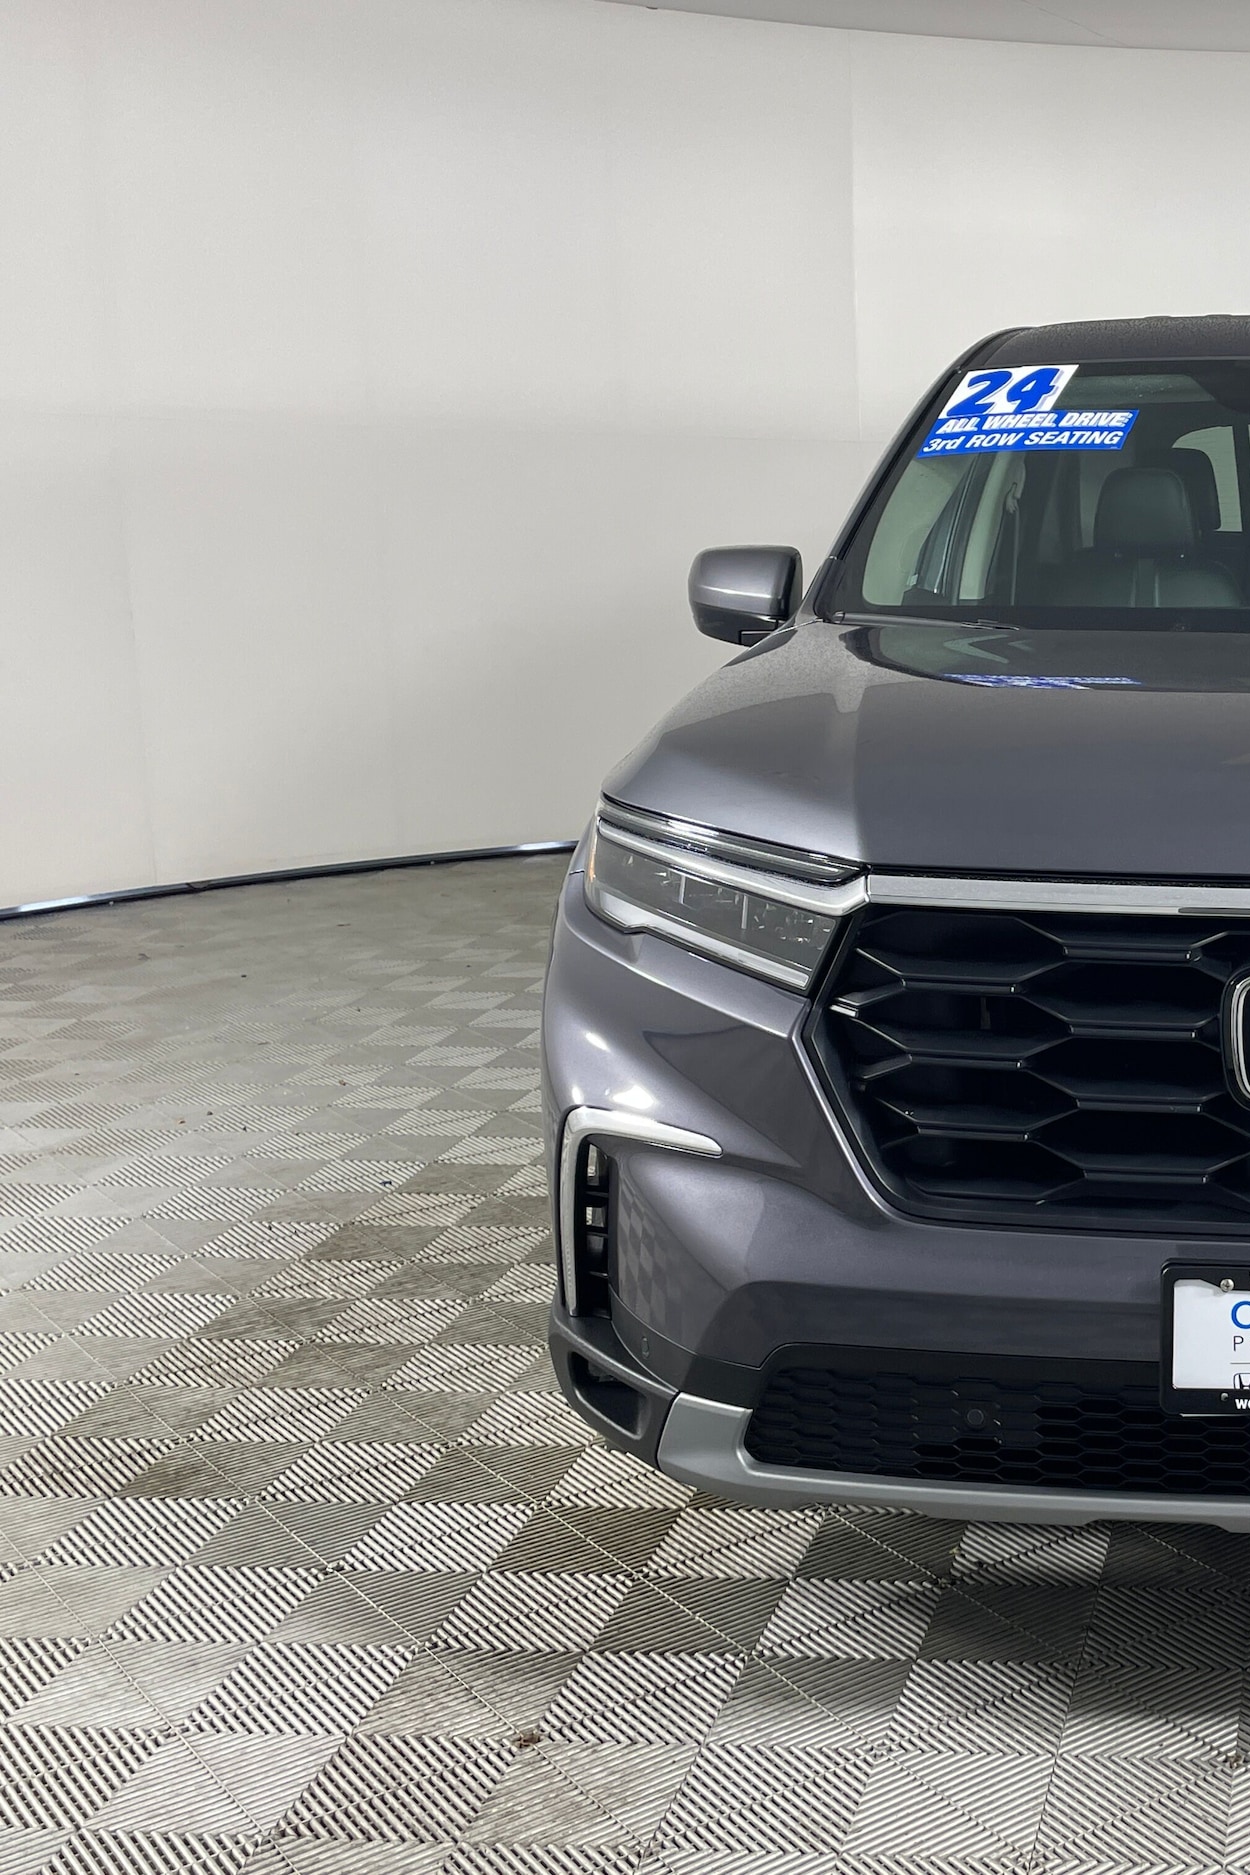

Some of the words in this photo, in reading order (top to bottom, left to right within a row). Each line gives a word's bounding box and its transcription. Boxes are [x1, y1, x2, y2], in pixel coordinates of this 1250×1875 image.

[946, 367, 1063, 416] 24
[935, 416, 981, 435] ALL
[981, 412, 1056, 430] WHEEL
[1058, 411, 1132, 428] DRIVE
[922, 435, 965, 452] 3rd
[965, 432, 1025, 449] ROW
[1024, 431, 1124, 446] SEATING
